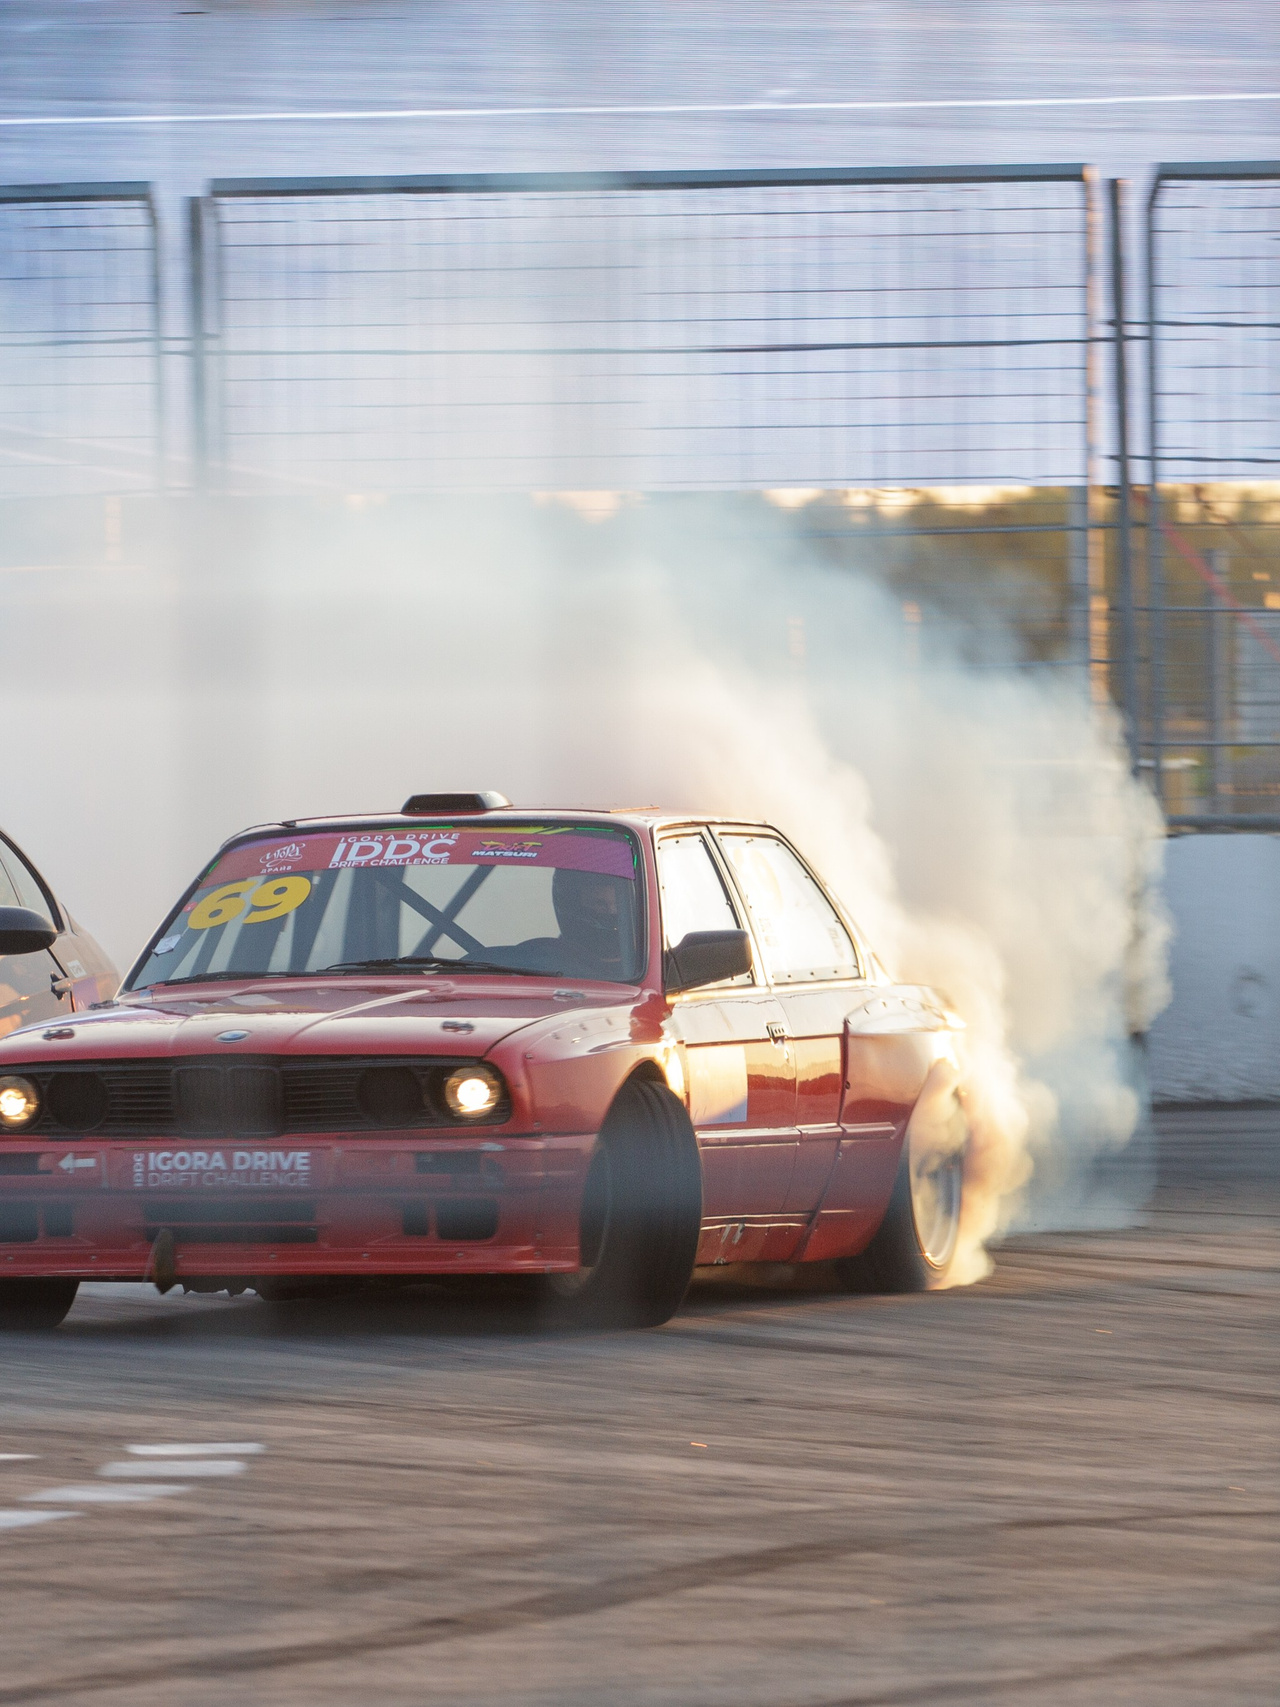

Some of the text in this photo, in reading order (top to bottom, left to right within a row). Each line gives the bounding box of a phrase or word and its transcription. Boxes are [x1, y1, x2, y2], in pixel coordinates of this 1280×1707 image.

[340, 832, 461, 843] IGORA DRIVE
[331, 838, 457, 862] IDDC
[471, 850, 538, 858] MATSURI
[328, 857, 450, 869] DRIFT CHALLENGE
[187, 876, 312, 930] 69
[148, 1151, 311, 1171] IGORA DRIVE
[148, 1172, 311, 1187] DRIFT CHALLENGE
